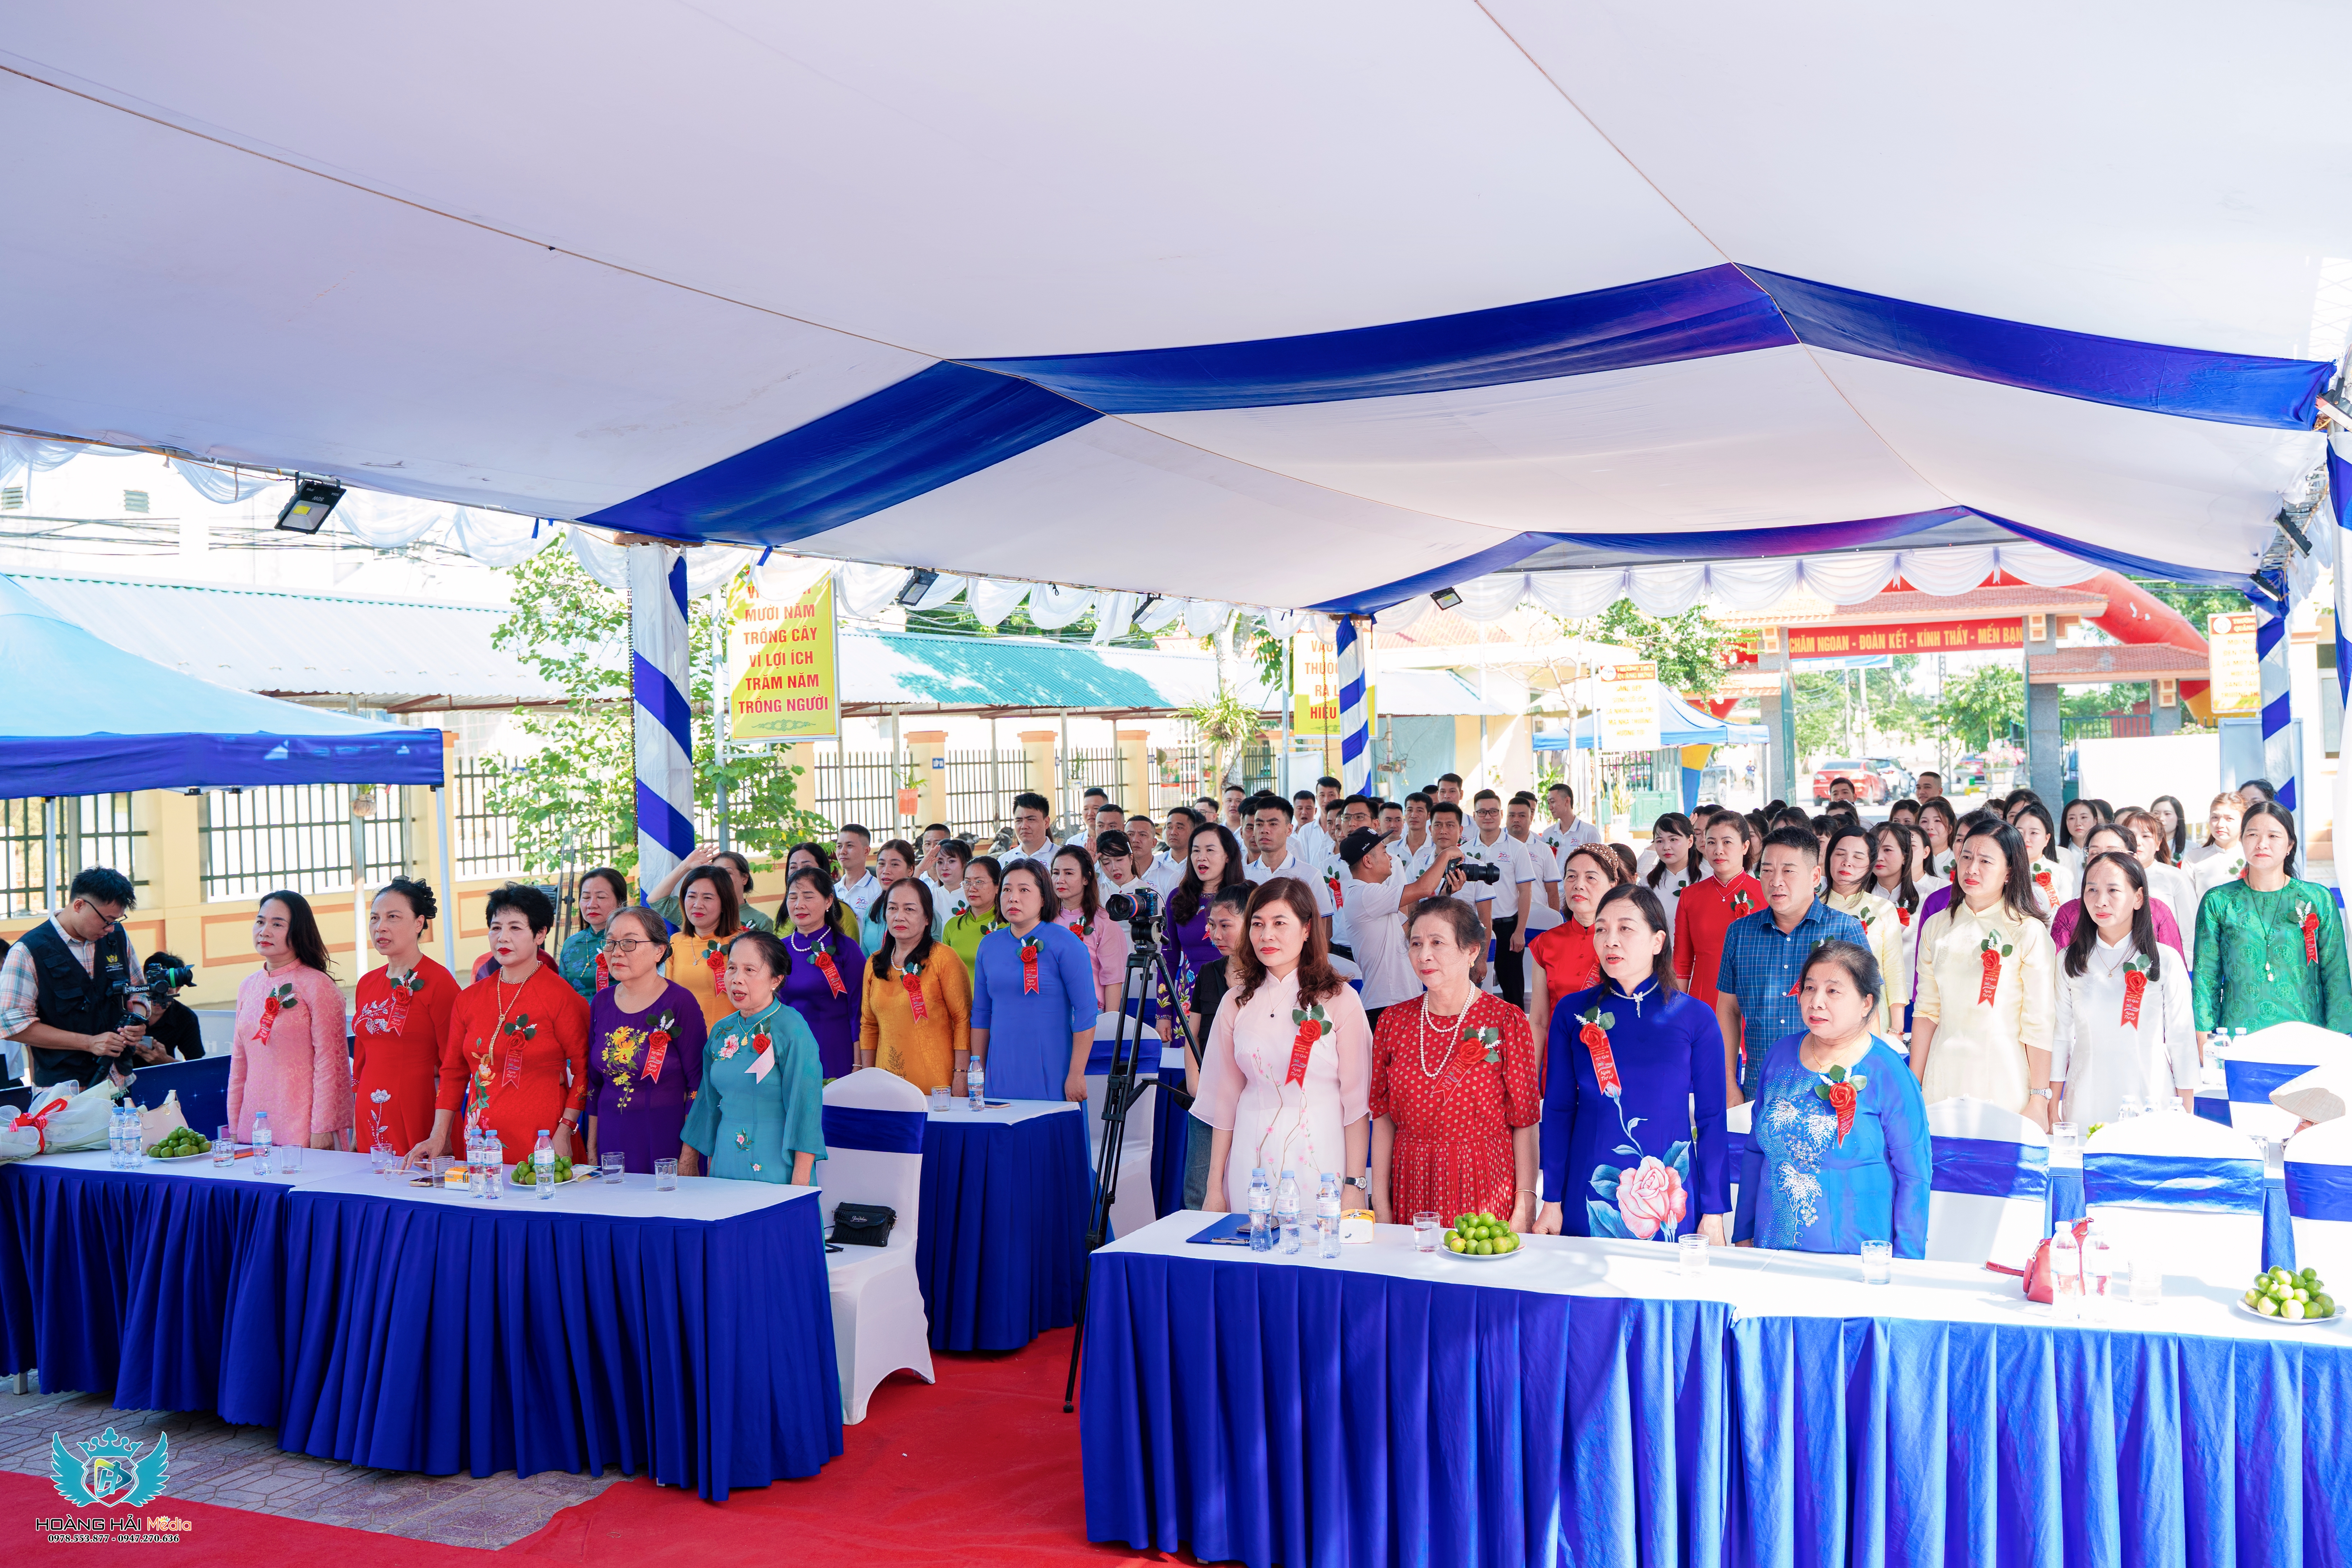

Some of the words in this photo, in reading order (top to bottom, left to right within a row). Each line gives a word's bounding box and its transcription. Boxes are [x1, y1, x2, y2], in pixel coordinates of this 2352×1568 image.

[745, 604, 779, 622] MƯỜI
[784, 602, 815, 619] NĂM
[744, 627, 787, 645] TRỒNG
[792, 625, 817, 641] CÂY
[1789, 635, 1815, 653] CHĂM
[1817, 635, 1849, 652] NGOAN
[1859, 631, 1885, 650] ĐOÀN
[1889, 628, 1907, 649] KẾT
[1917, 628, 1940, 647] KÍNH
[1944, 624, 1968, 646] THẦY
[1978, 623, 2000, 644] MẾN
[2003, 627, 2023, 645] BẠN
[750, 651, 761, 667] VÌ
[766, 651, 786, 669] LỢI
[791, 649, 813, 665] ÍCH
[746, 674, 782, 691] TRĂM
[788, 672, 819, 688] NĂM
[739, 696, 782, 714] TRỒNG
[787, 694, 829, 712] NGƯỜI
